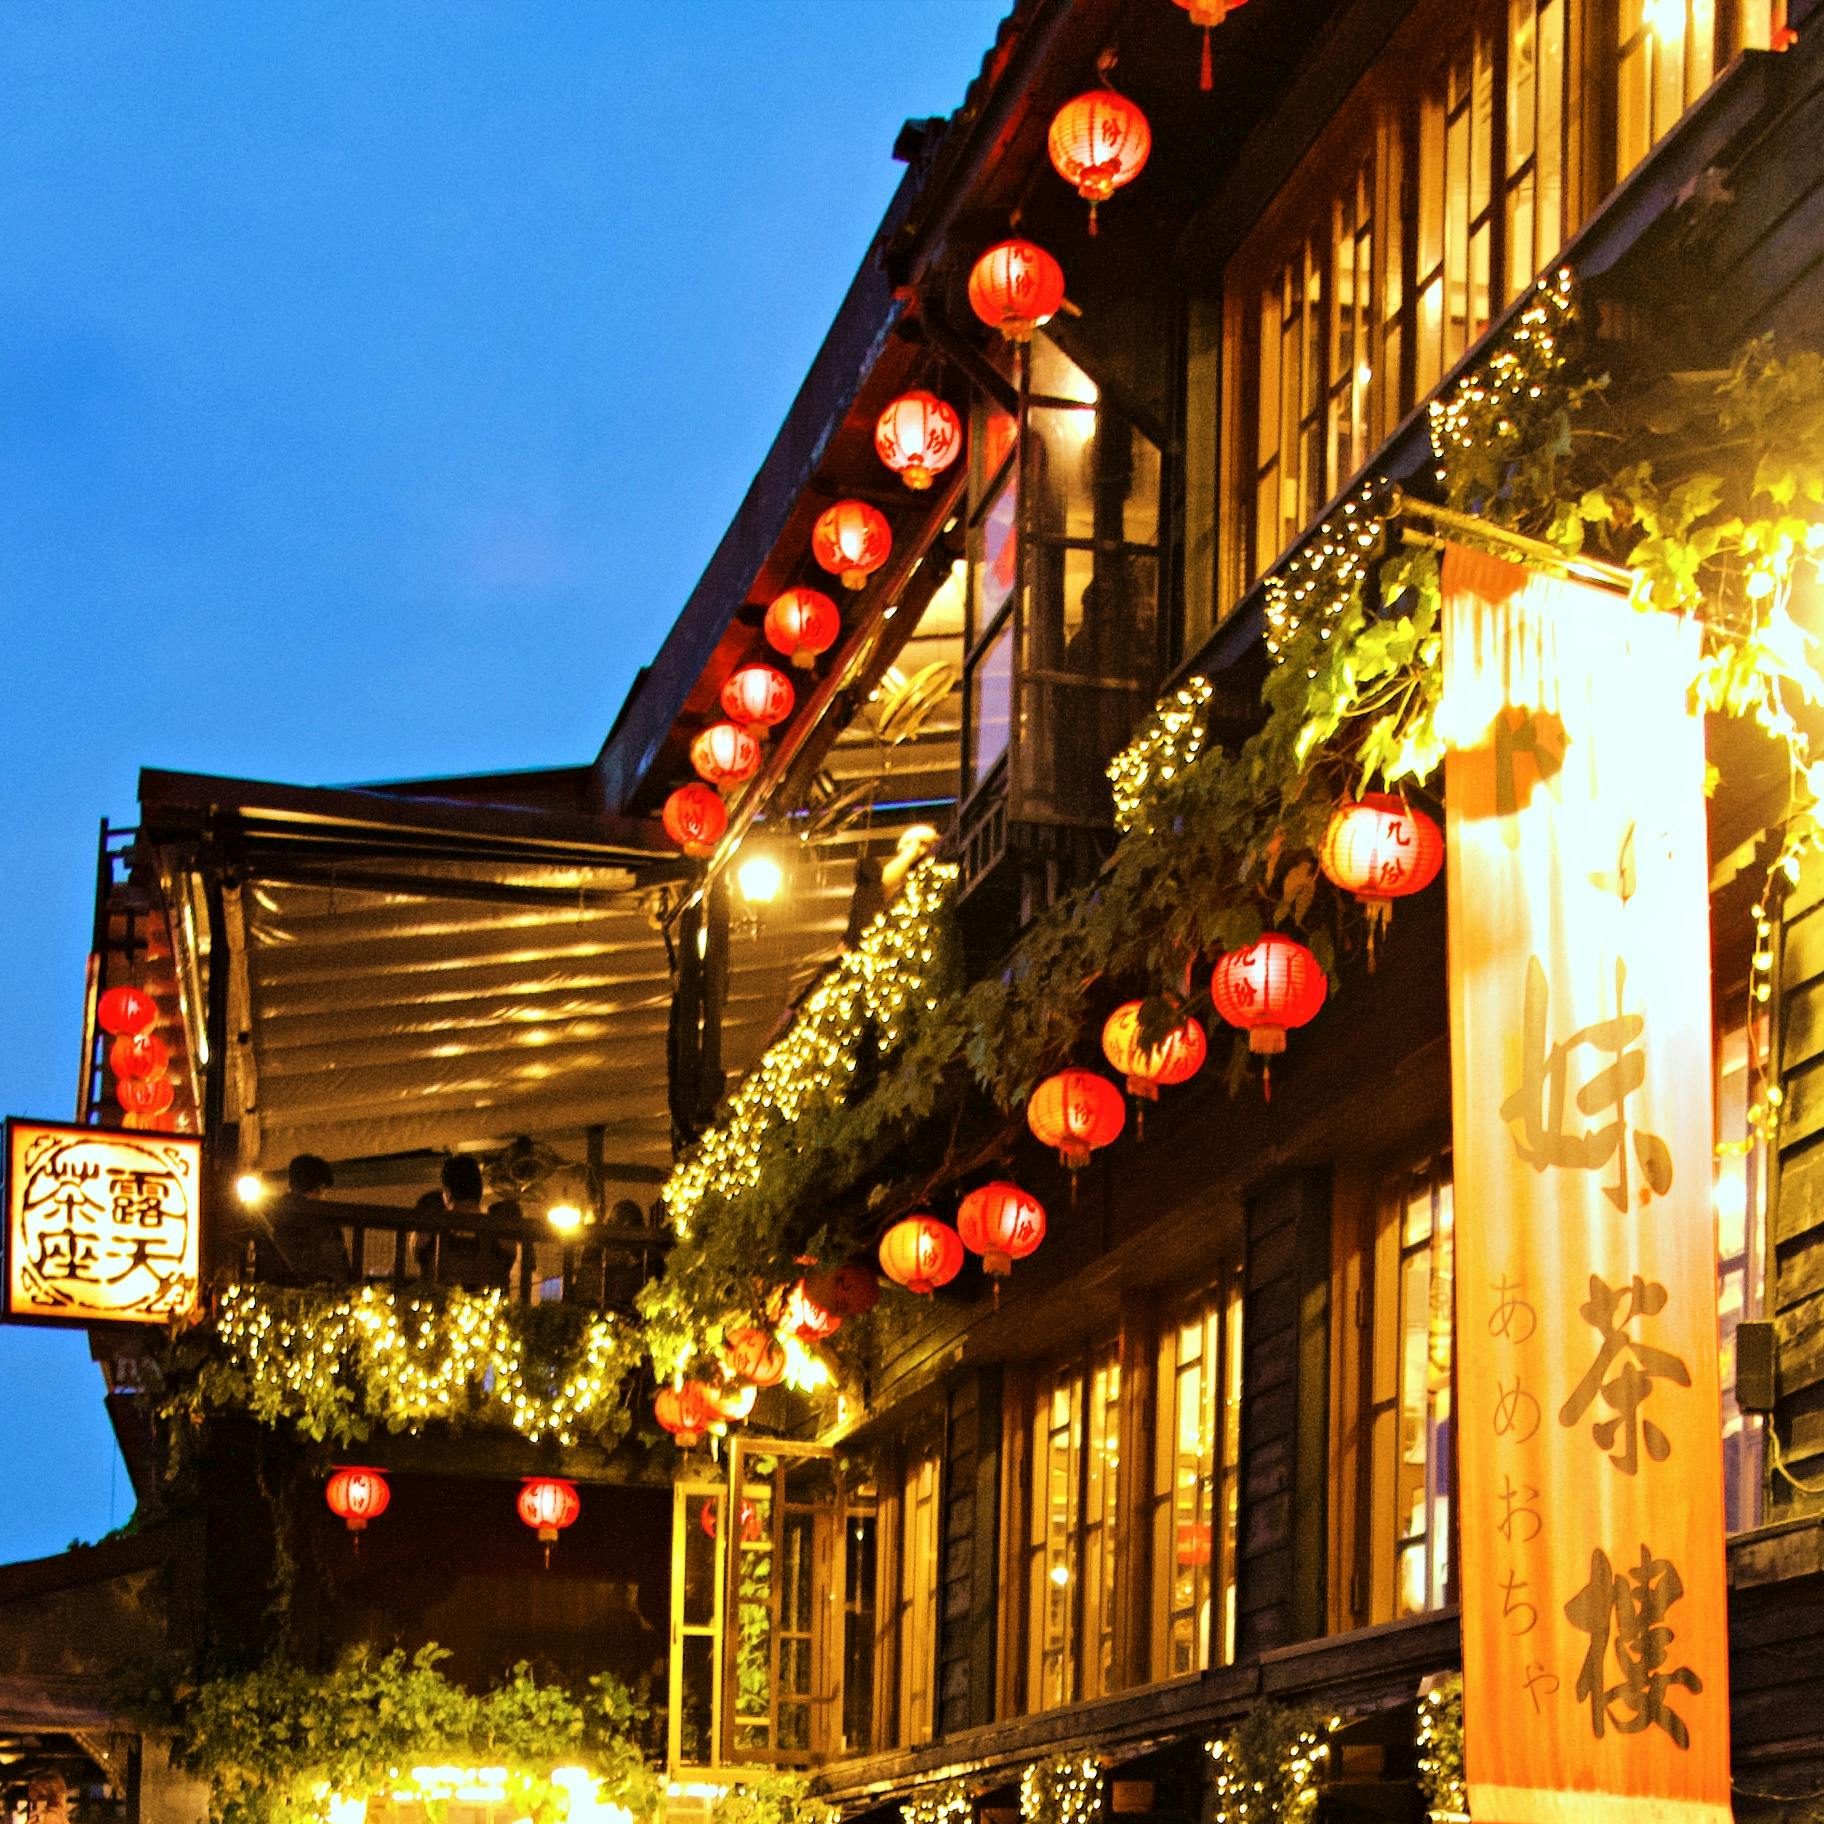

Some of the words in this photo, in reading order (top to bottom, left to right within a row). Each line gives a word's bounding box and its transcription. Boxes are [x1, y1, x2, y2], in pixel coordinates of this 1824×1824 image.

[1379, 820, 1411, 884] 九份
[28, 1161, 106, 1284] 茶座
[106, 1167, 185, 1284] 露天
[1486, 1274, 1561, 1714] あめおちゃ
